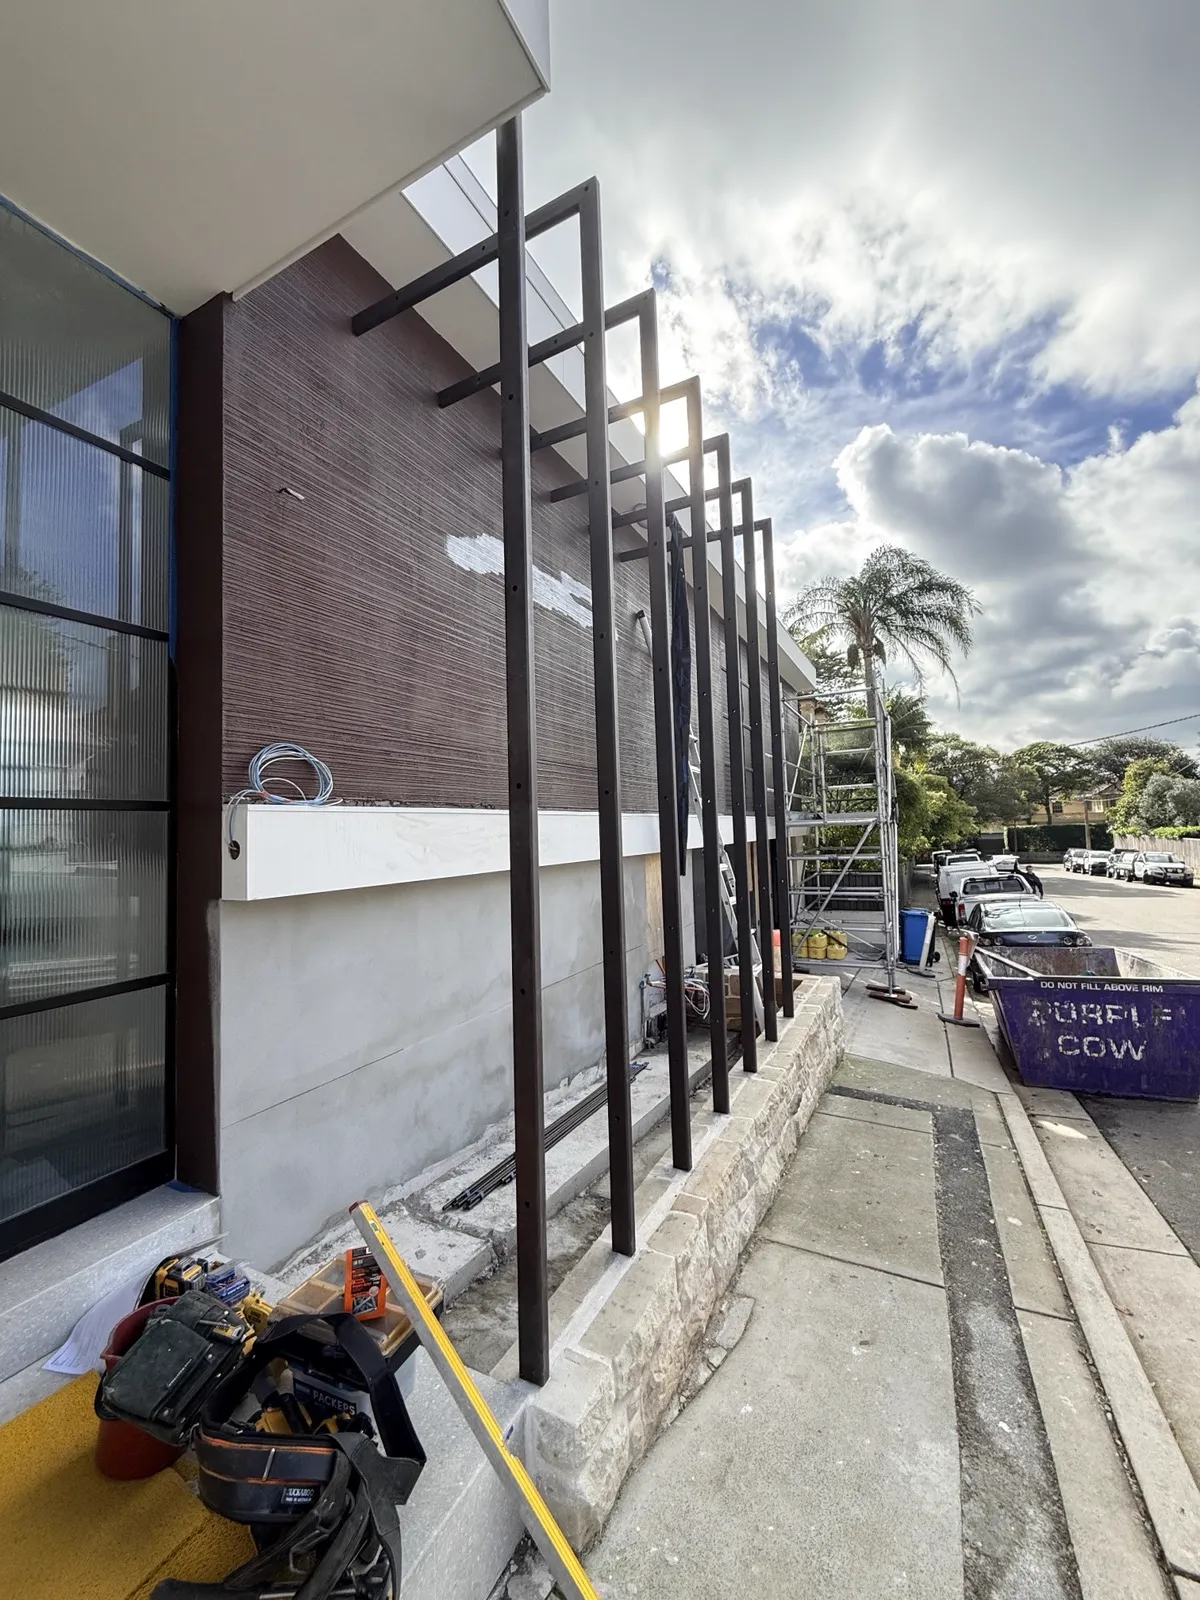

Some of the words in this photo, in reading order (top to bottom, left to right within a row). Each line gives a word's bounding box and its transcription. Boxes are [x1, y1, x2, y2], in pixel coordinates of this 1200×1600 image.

[1040, 981, 1055, 989] DO
[1057, 982, 1078, 990] NOT
[1081, 983, 1101, 991] FILL
[1103, 983, 1139, 992] ABOVE
[1141, 984, 1164, 993] RIM
[1058, 1034, 1148, 1061] COW
[312, 1390, 356, 1416] PACKERS
